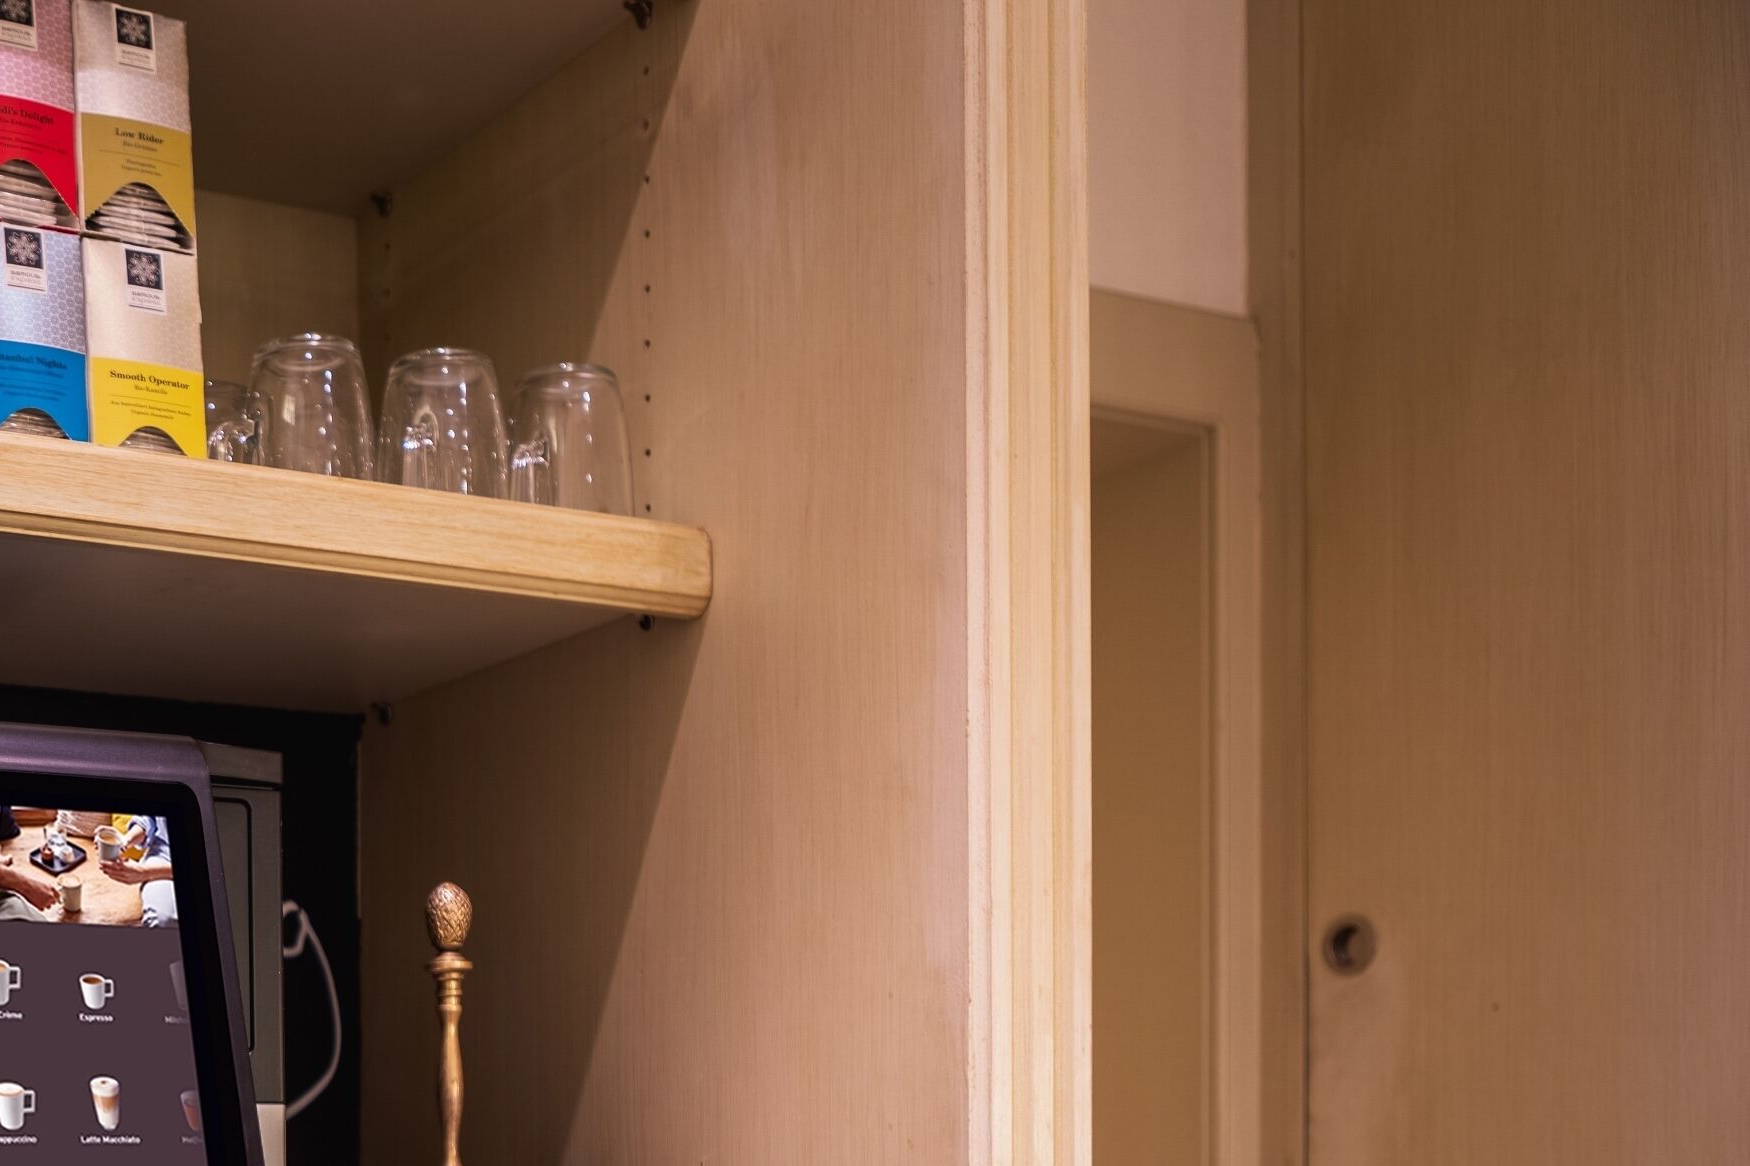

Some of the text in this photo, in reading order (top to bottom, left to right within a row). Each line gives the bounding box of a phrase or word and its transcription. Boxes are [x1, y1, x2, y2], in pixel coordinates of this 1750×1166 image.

[115, 127, 164, 145] Low Rider
[109, 370, 190, 390] Smooth Operator
[79, 1013, 114, 1023] Espresso
[80, 1135, 140, 1144] Latte Macchiato
